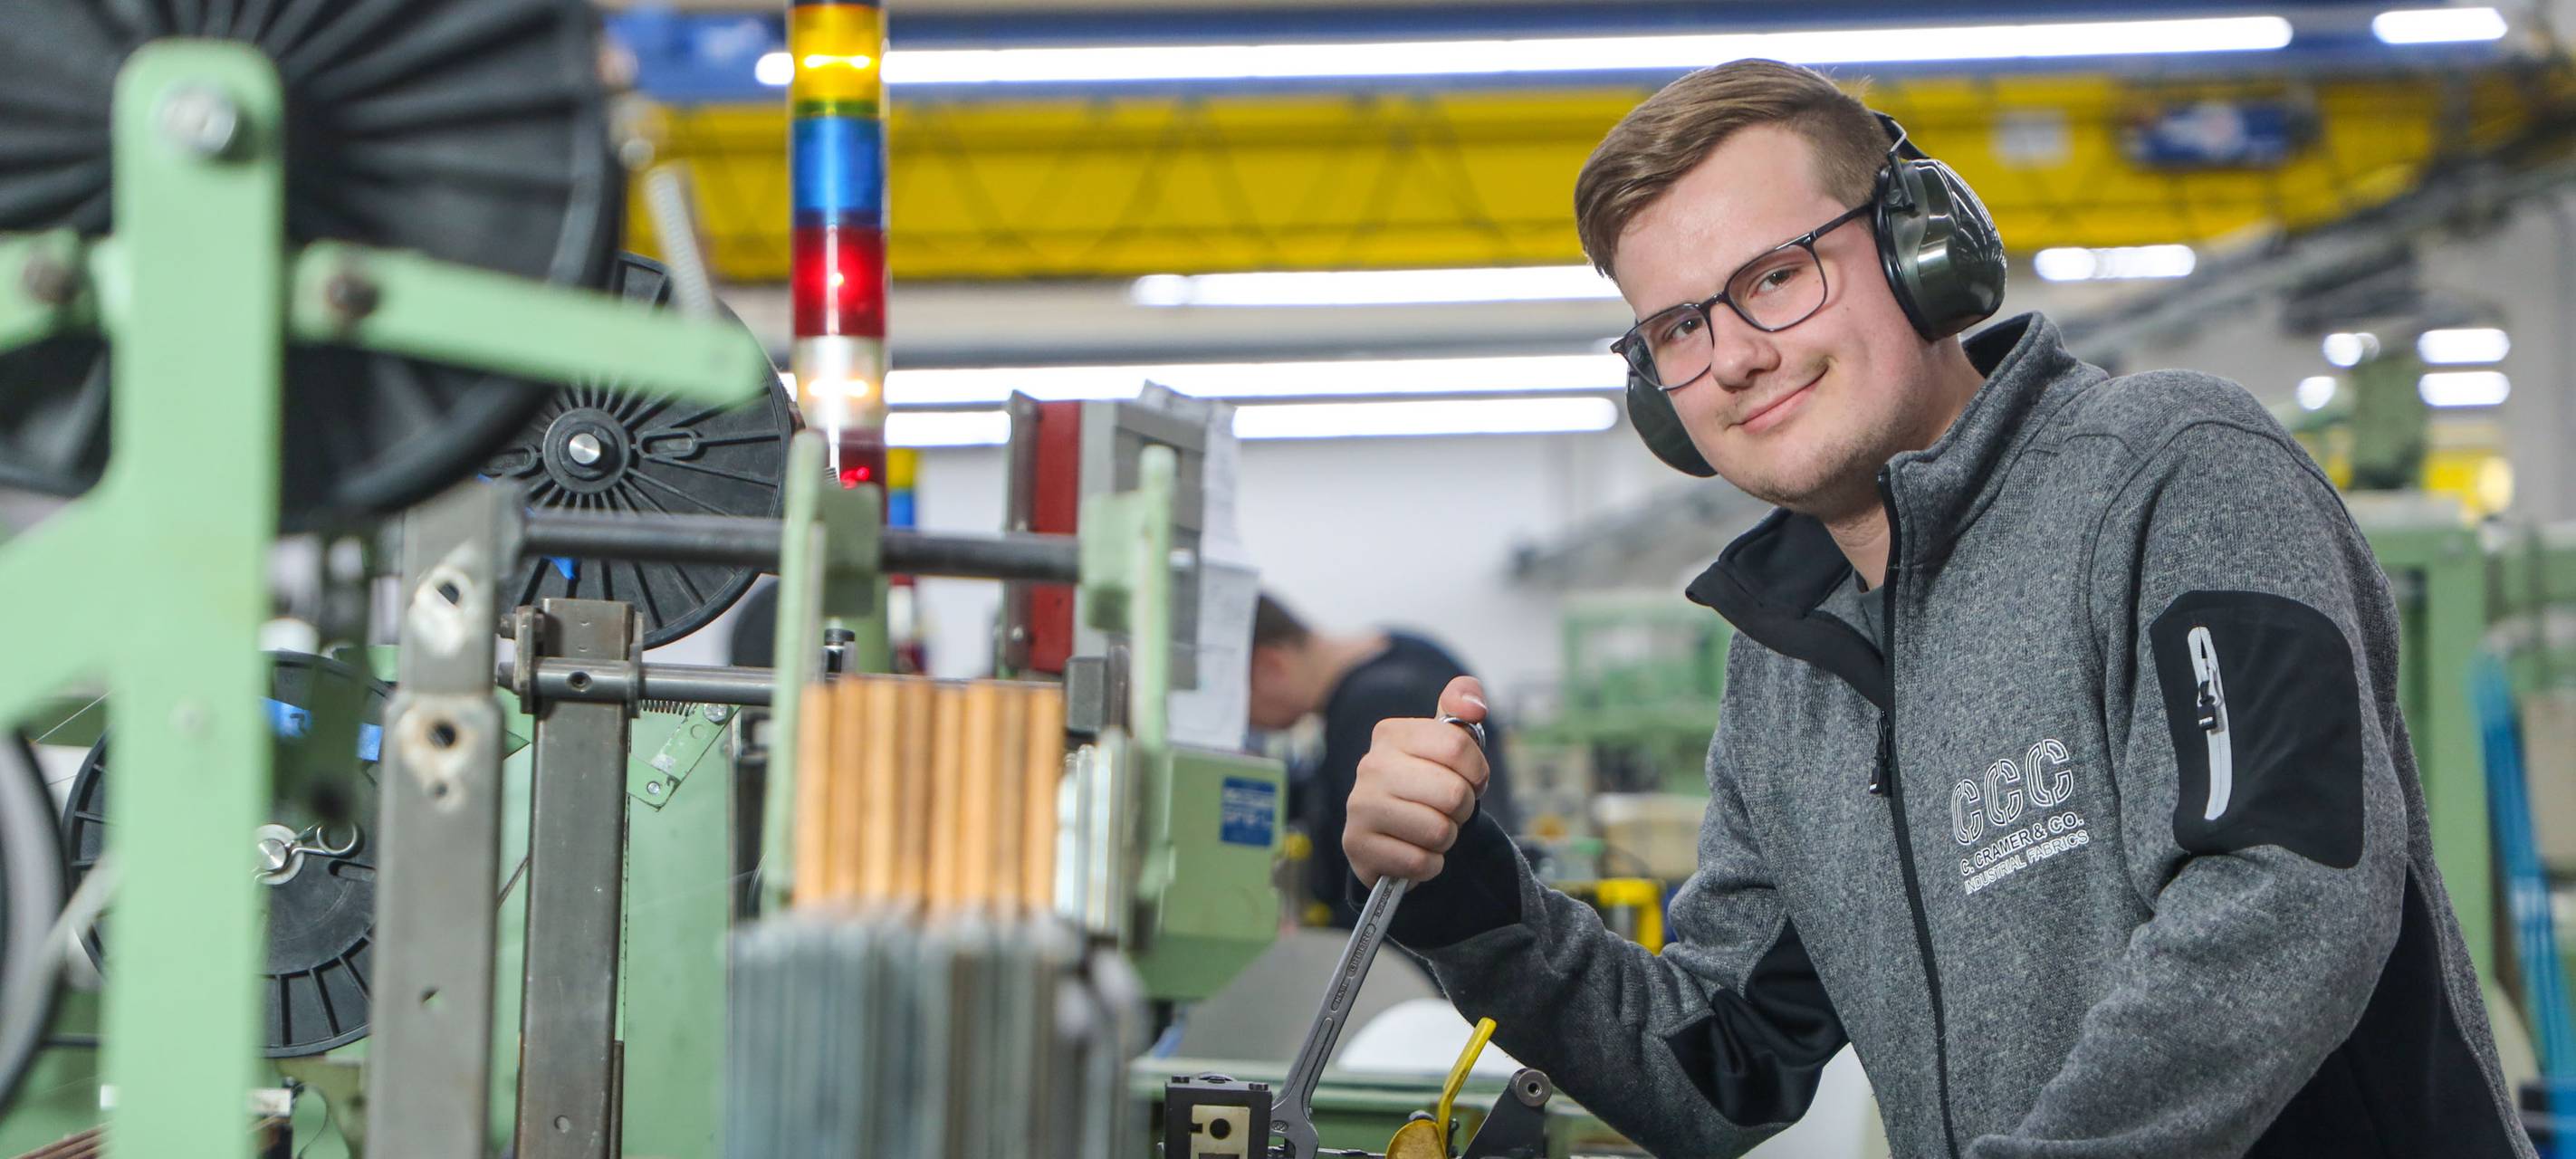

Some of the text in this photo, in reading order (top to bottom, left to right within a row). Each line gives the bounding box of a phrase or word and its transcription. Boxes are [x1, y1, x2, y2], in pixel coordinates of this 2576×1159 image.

[1951, 739, 2073, 845] CCC
[1960, 811, 2084, 876] C. CRAMER & CO.
[1964, 829, 2090, 895] INDUSTRIAL FABRICS
